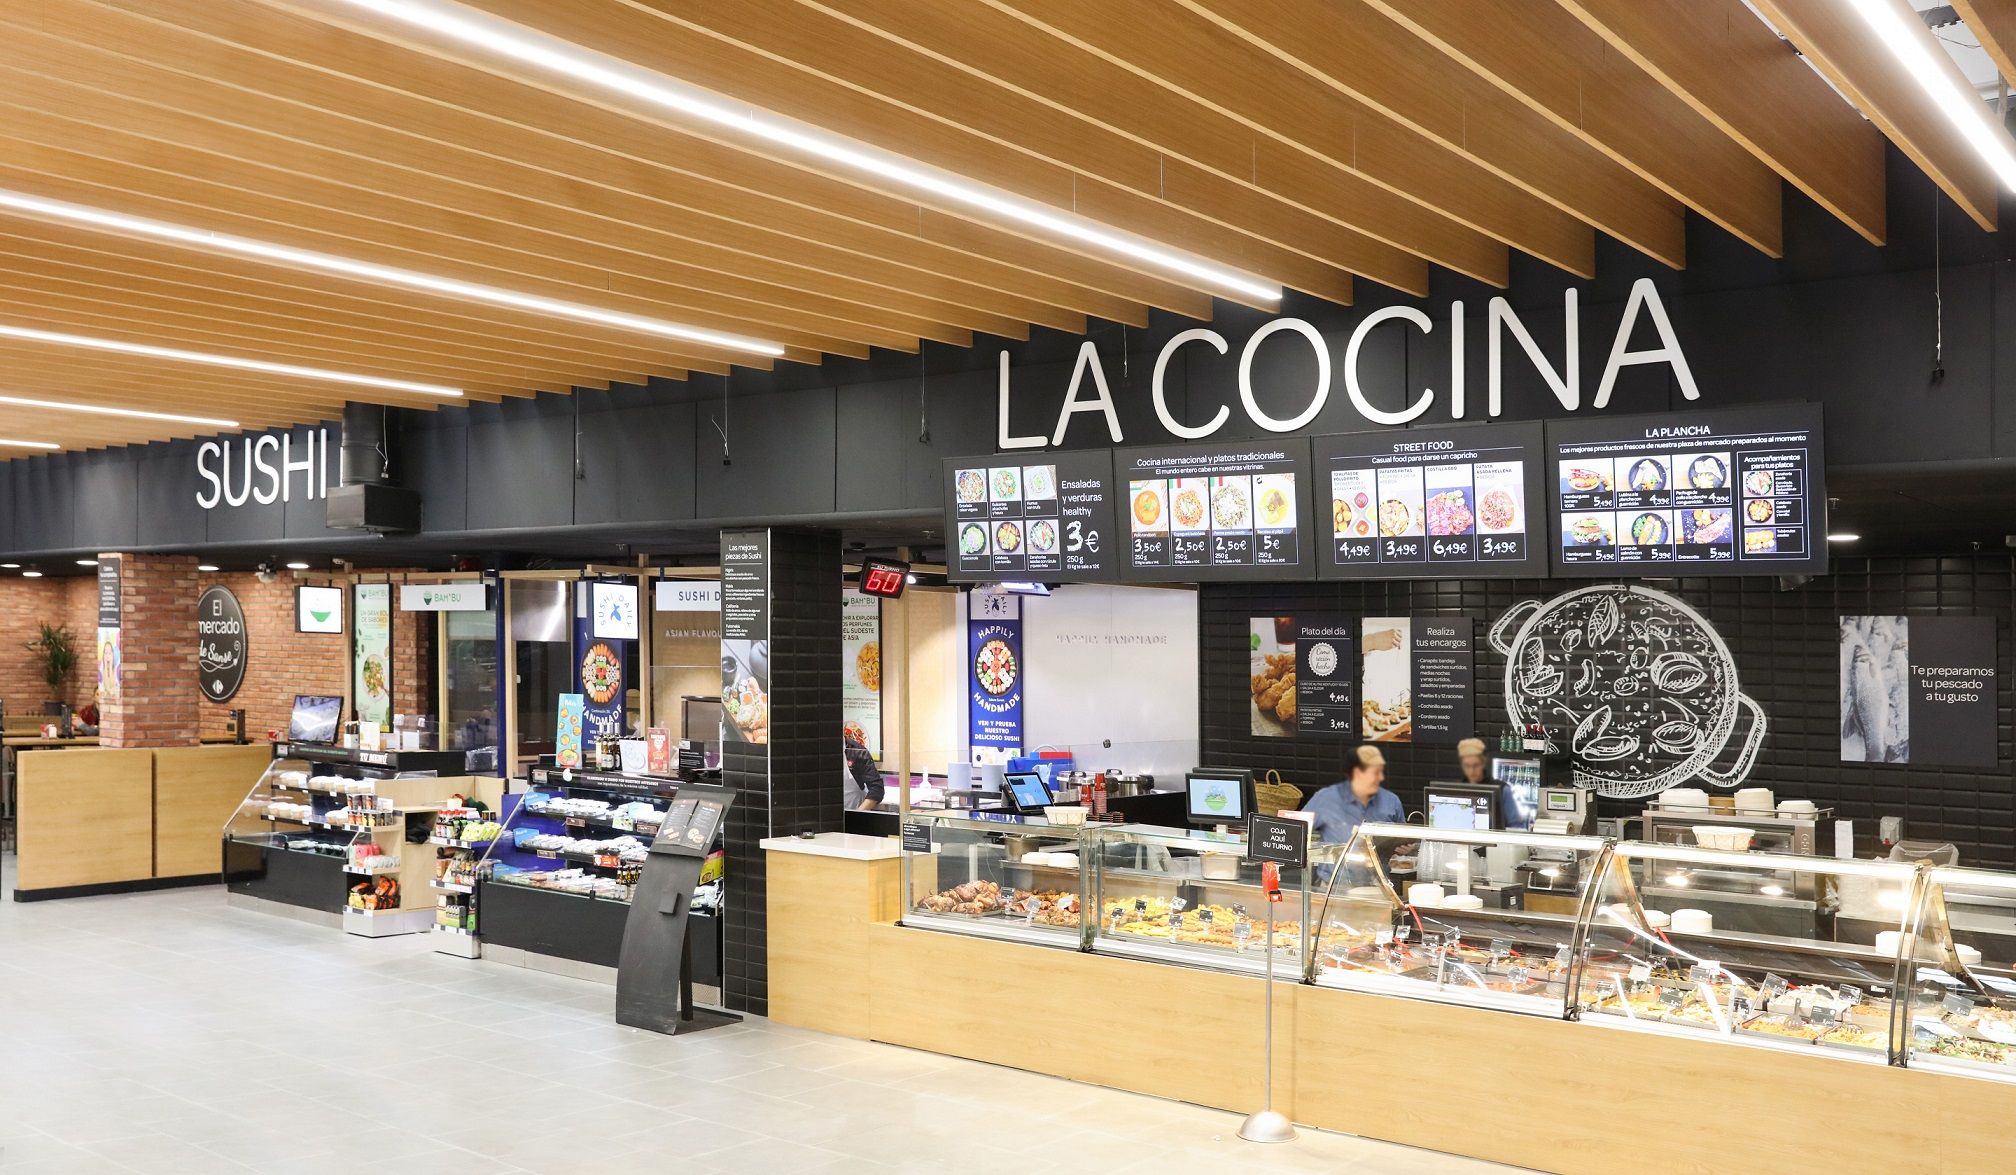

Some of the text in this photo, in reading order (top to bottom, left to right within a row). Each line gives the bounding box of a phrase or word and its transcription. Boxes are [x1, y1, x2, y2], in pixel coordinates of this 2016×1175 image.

[1000, 277, 1701, 449] LA COCINA
[1646, 426, 1710, 438] LA PLANCHA
[1393, 441, 1453, 452] STREET FOOD
[1137, 458, 1160, 466] Cocina
[1162, 455, 1207, 465] internacional
[1214, 454, 1236, 464] platos
[1237, 451, 1284, 460] tradicionales
[1450, 452, 1478, 460] capricho
[1744, 455, 1800, 463] Acompañamientos
[196, 428, 327, 509] SUSHI
[1062, 479, 1100, 489] Ensaladas
[1062, 493, 1102, 504] y verduras
[1594, 496, 1612, 508] 5,49€
[1650, 494, 1669, 506] 4,99€
[1708, 492, 1729, 504] 4,99€
[1062, 507, 1092, 517] healthy
[738, 544, 758, 552] mejores
[1135, 539, 1162, 554] 3,50€
[1175, 538, 1204, 554] 2,50€
[1216, 537, 1246, 553] 2,50€
[1264, 535, 1280, 550] 5€
[1433, 539, 1467, 557] 6,49€
[1483, 538, 1516, 557] 3,49€
[1339, 542, 1370, 556] 4,49€
[1387, 541, 1417, 558] 3,49€
[1652, 549, 1671, 560] 5,99€
[1710, 548, 1730, 560] 5,99€
[1080, 556, 1084, 564] g
[1596, 550, 1614, 561] 5,49€
[866, 570, 902, 592] 60
[678, 591, 710, 601] SUSHI
[213, 600, 222, 616] El
[598, 593, 633, 628] SUSHI DAILY
[978, 626, 1014, 639] HAPPILY
[1334, 627, 1345, 635] día
[1427, 627, 1455, 636] Realiza
[1430, 640, 1466, 648] encargos
[208, 642, 232, 663] Sanse
[1910, 665, 1994, 677] Te preparamos
[1922, 679, 1983, 690] tu pescado
[974, 692, 1020, 712] HANDMADE
[1330, 692, 1349, 703] 4,49€
[1935, 692, 1945, 700] tu
[1947, 693, 1978, 704] gusto
[1331, 719, 1349, 729] 3,49€
[1272, 843, 1292, 851] TURNO
